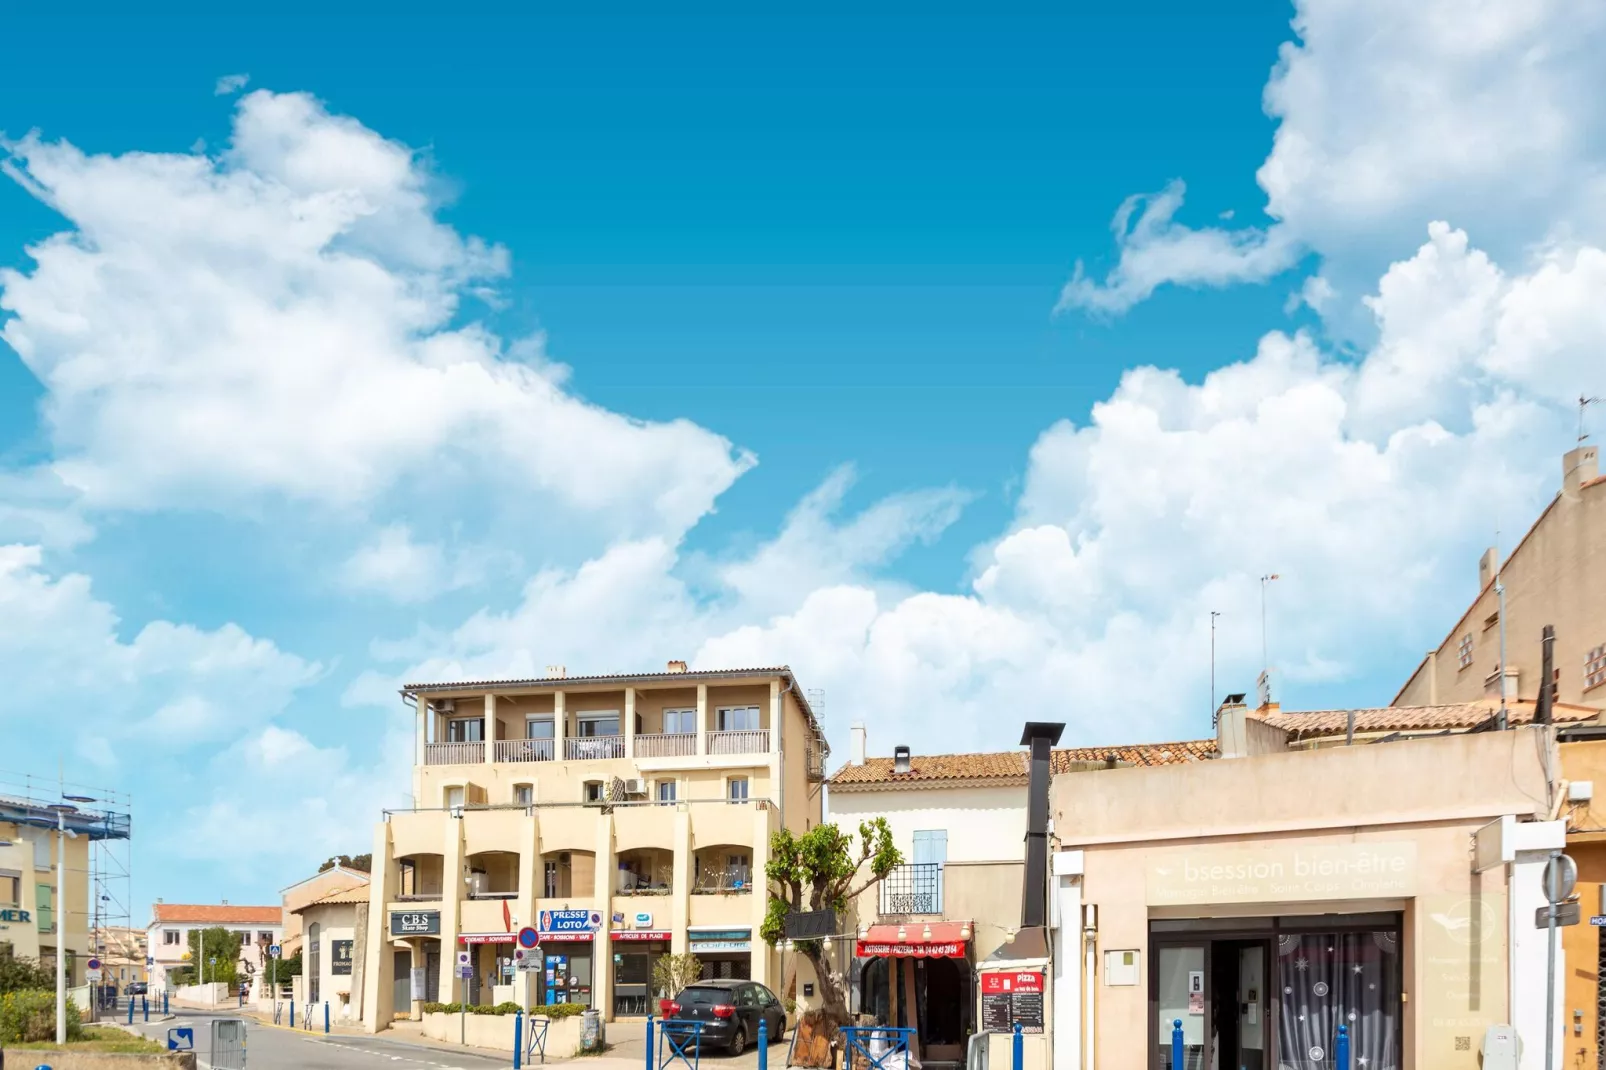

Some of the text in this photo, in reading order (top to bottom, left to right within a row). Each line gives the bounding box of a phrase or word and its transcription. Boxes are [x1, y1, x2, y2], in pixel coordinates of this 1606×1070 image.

[1184, 850, 1406, 883] bsession bien-être
[553, 911, 587, 919] PRESSE
[557, 921, 582, 929] LOTO
[893, 945, 914, 954] PIZZERIA
[1017, 973, 1036, 983] pizza
